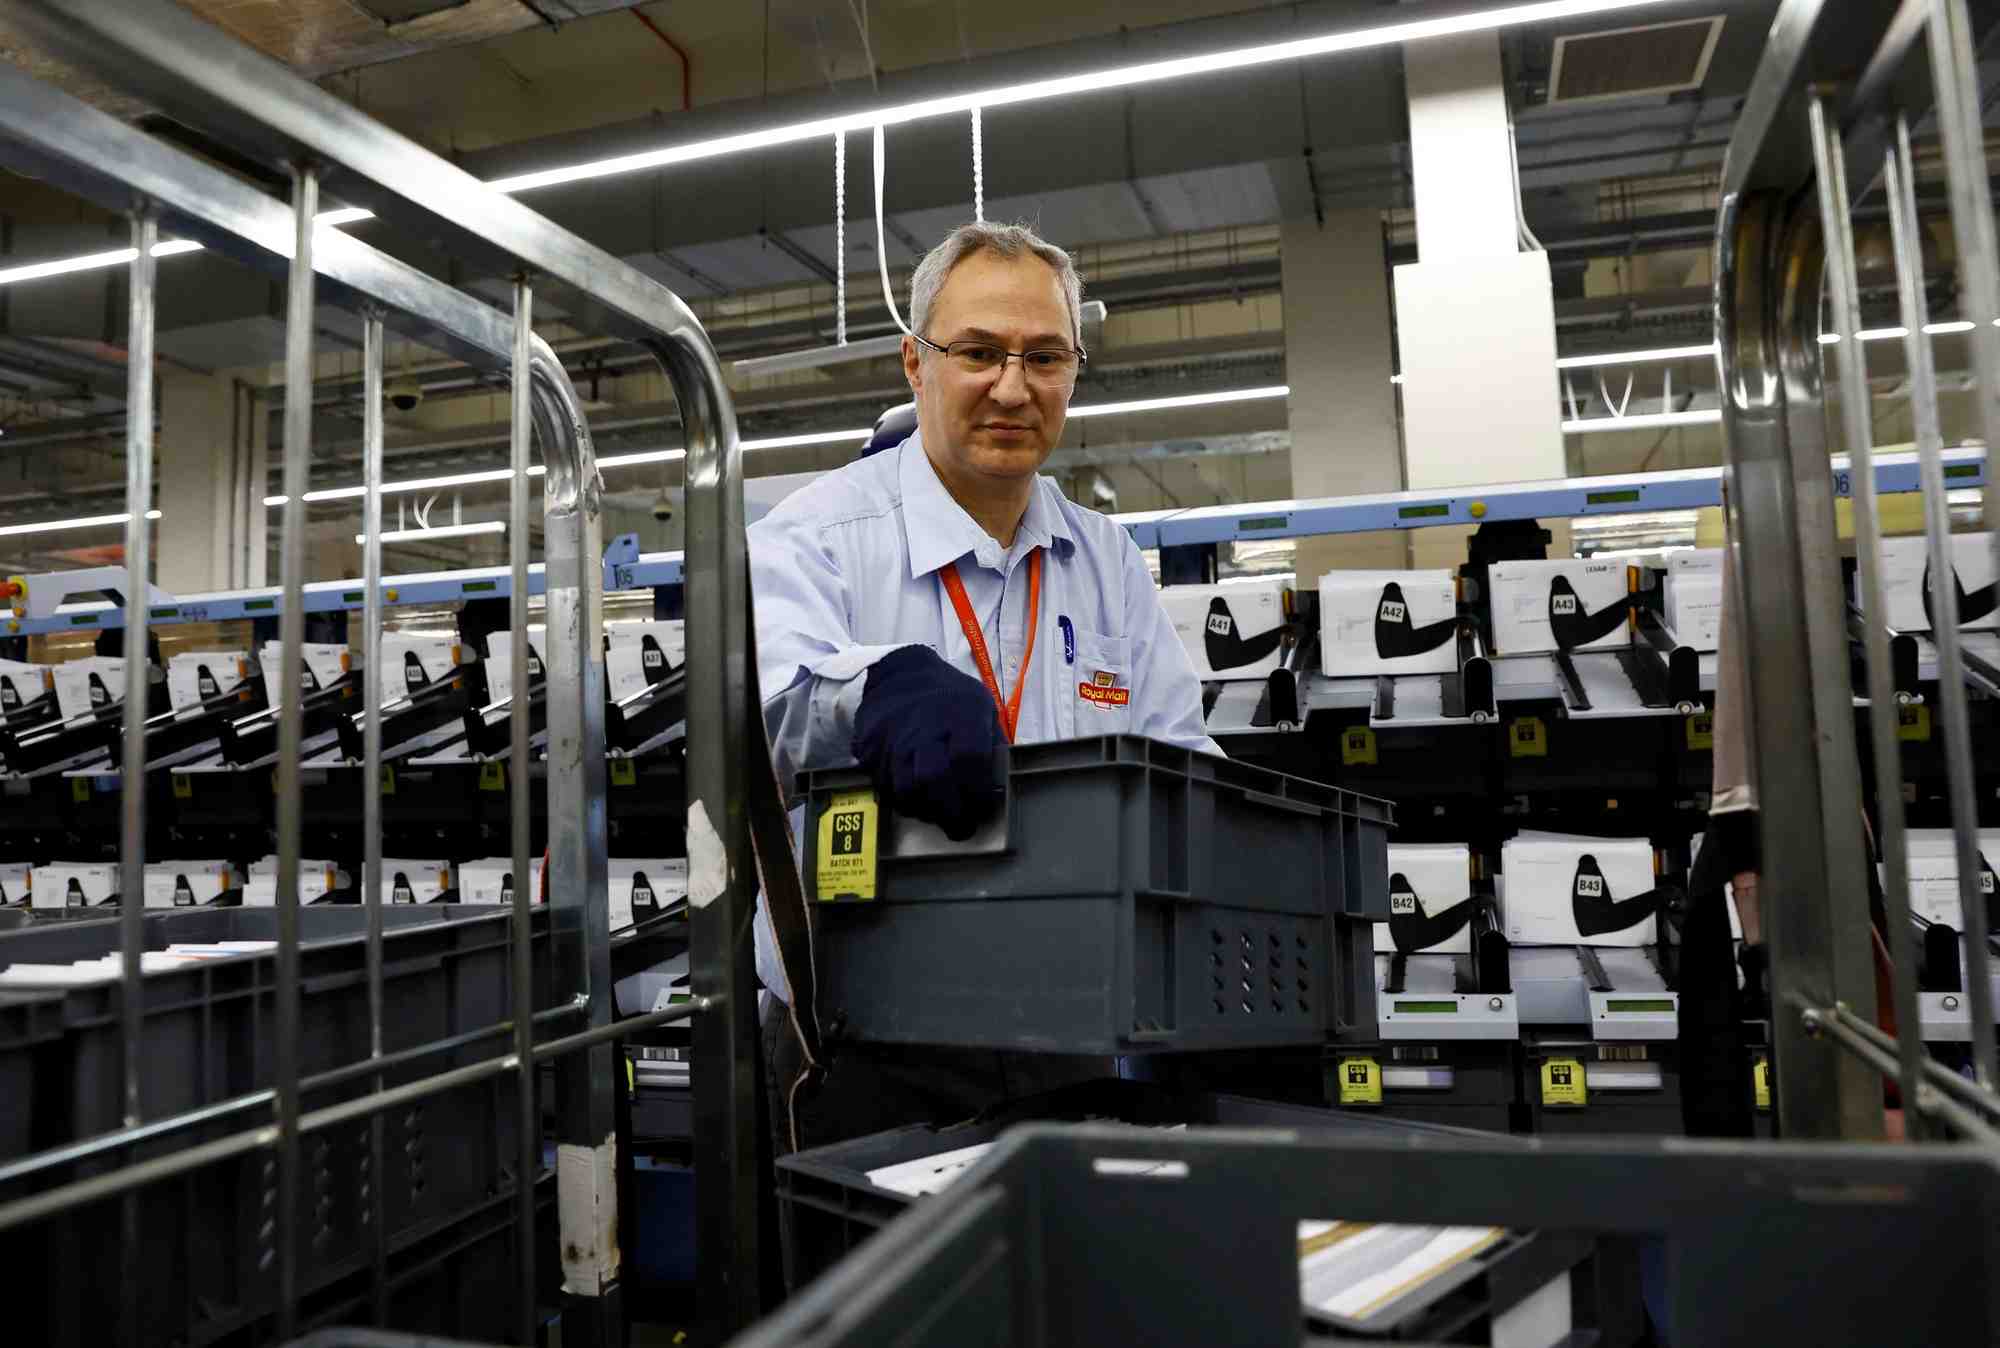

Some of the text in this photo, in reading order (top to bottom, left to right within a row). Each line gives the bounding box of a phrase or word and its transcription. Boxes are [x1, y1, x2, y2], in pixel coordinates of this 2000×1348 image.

[1555, 599, 1574, 609] A43
[1382, 605, 1402, 617] A42
[1209, 618, 1228, 630] A41
[1082, 686, 1127, 701] Royal Mail
[836, 814, 860, 832] CSS
[844, 834, 852, 851] 8
[1580, 879, 1600, 891] B43
[1393, 897, 1413, 909] B42
